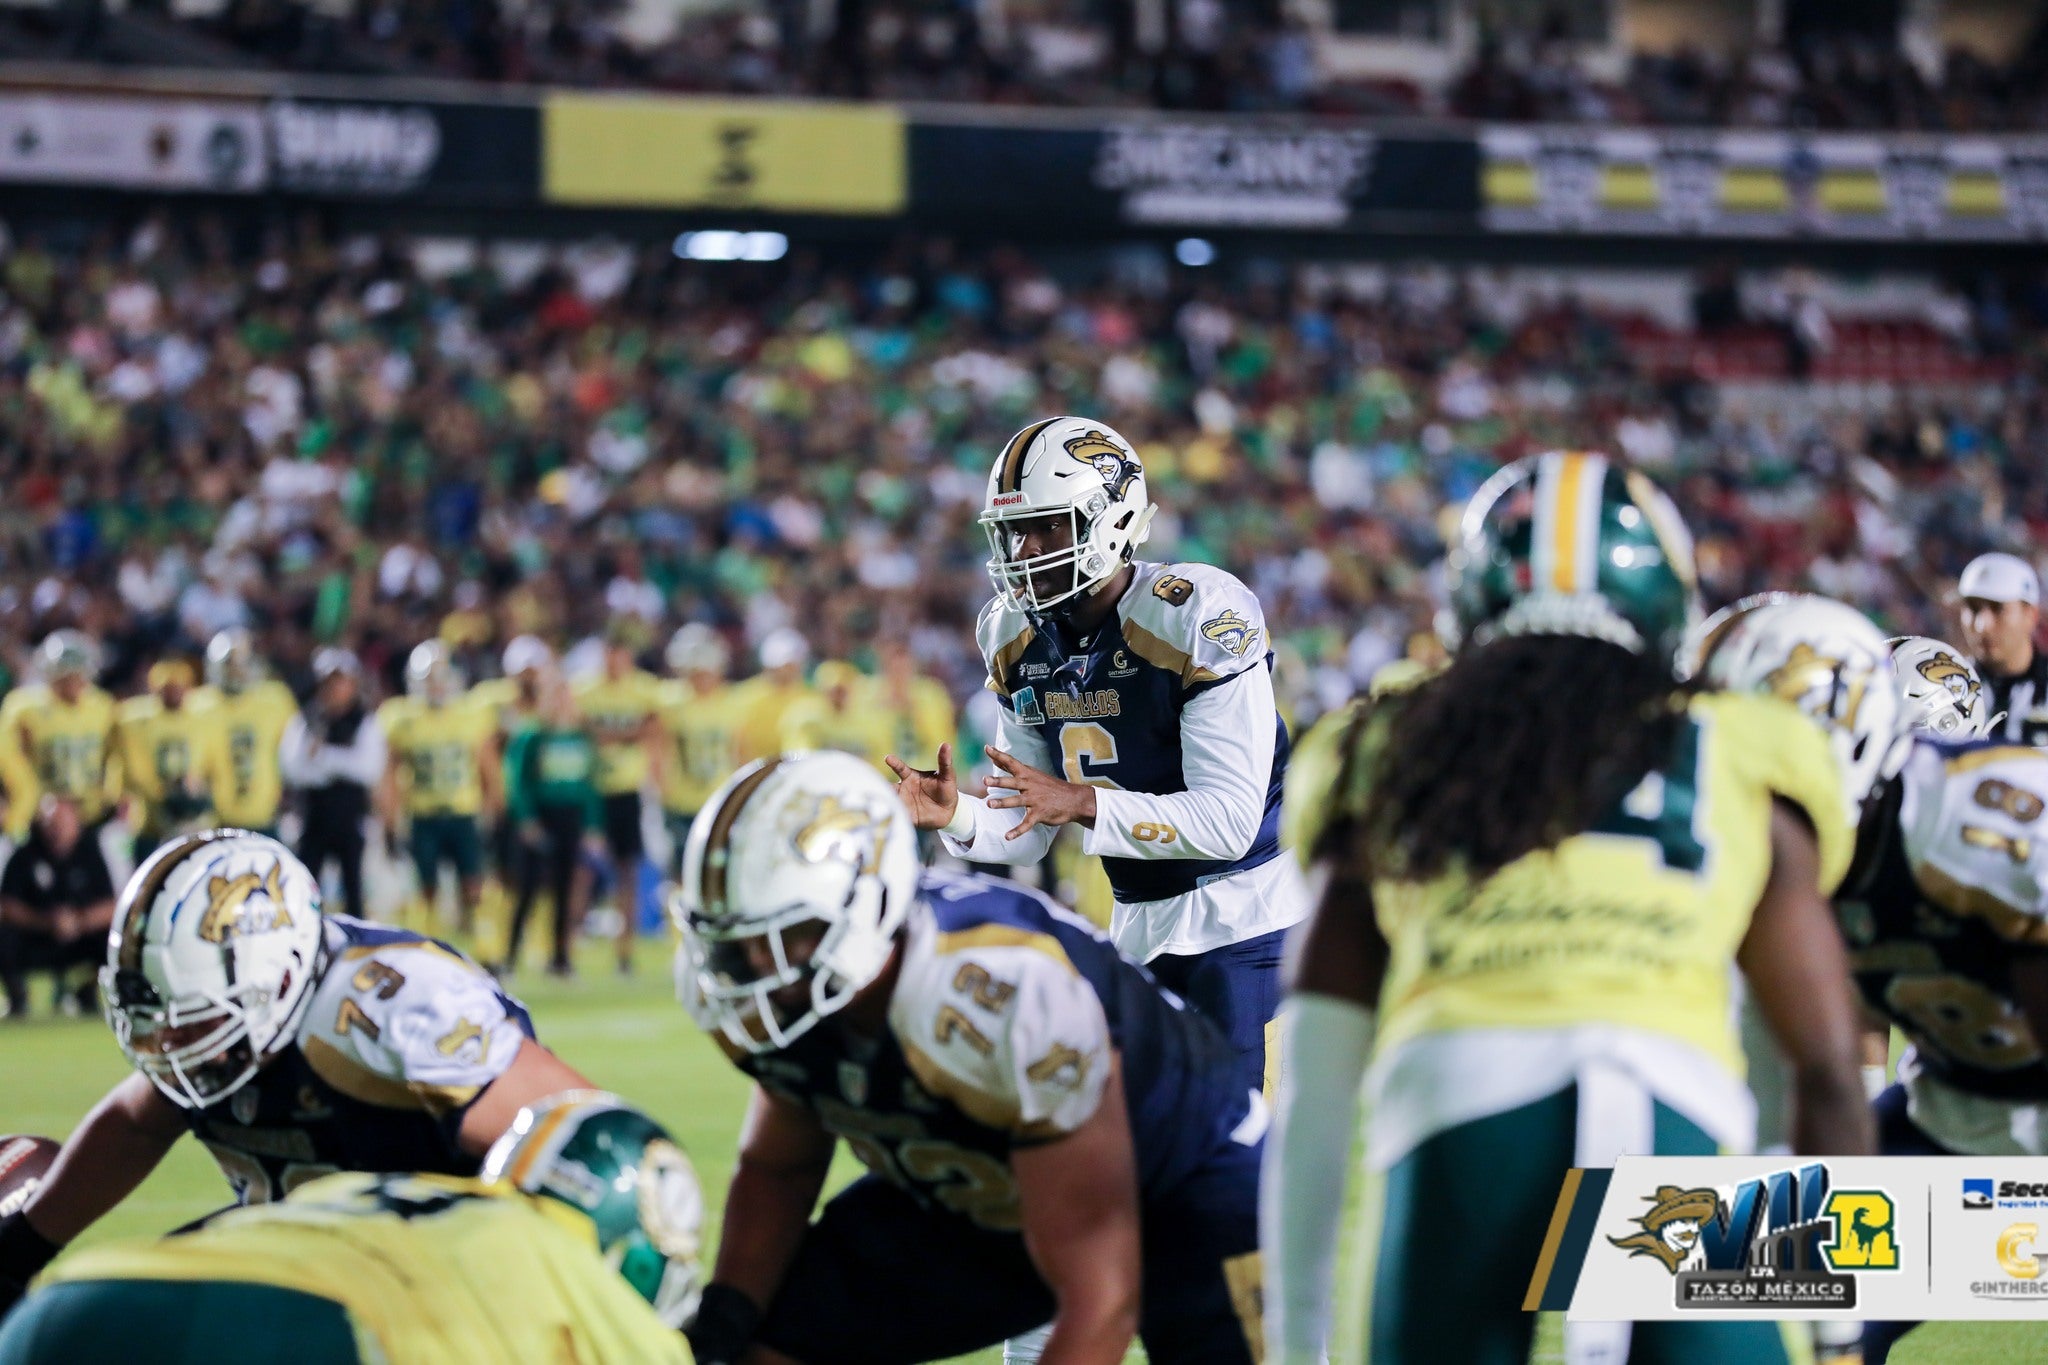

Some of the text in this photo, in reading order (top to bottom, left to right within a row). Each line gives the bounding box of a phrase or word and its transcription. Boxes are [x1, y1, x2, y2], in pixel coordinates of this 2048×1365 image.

[993, 494, 1022, 506] Riddell
[1153, 574, 1194, 607] 6
[335, 960, 405, 1041] 79
[934, 961, 1015, 1057] 72
